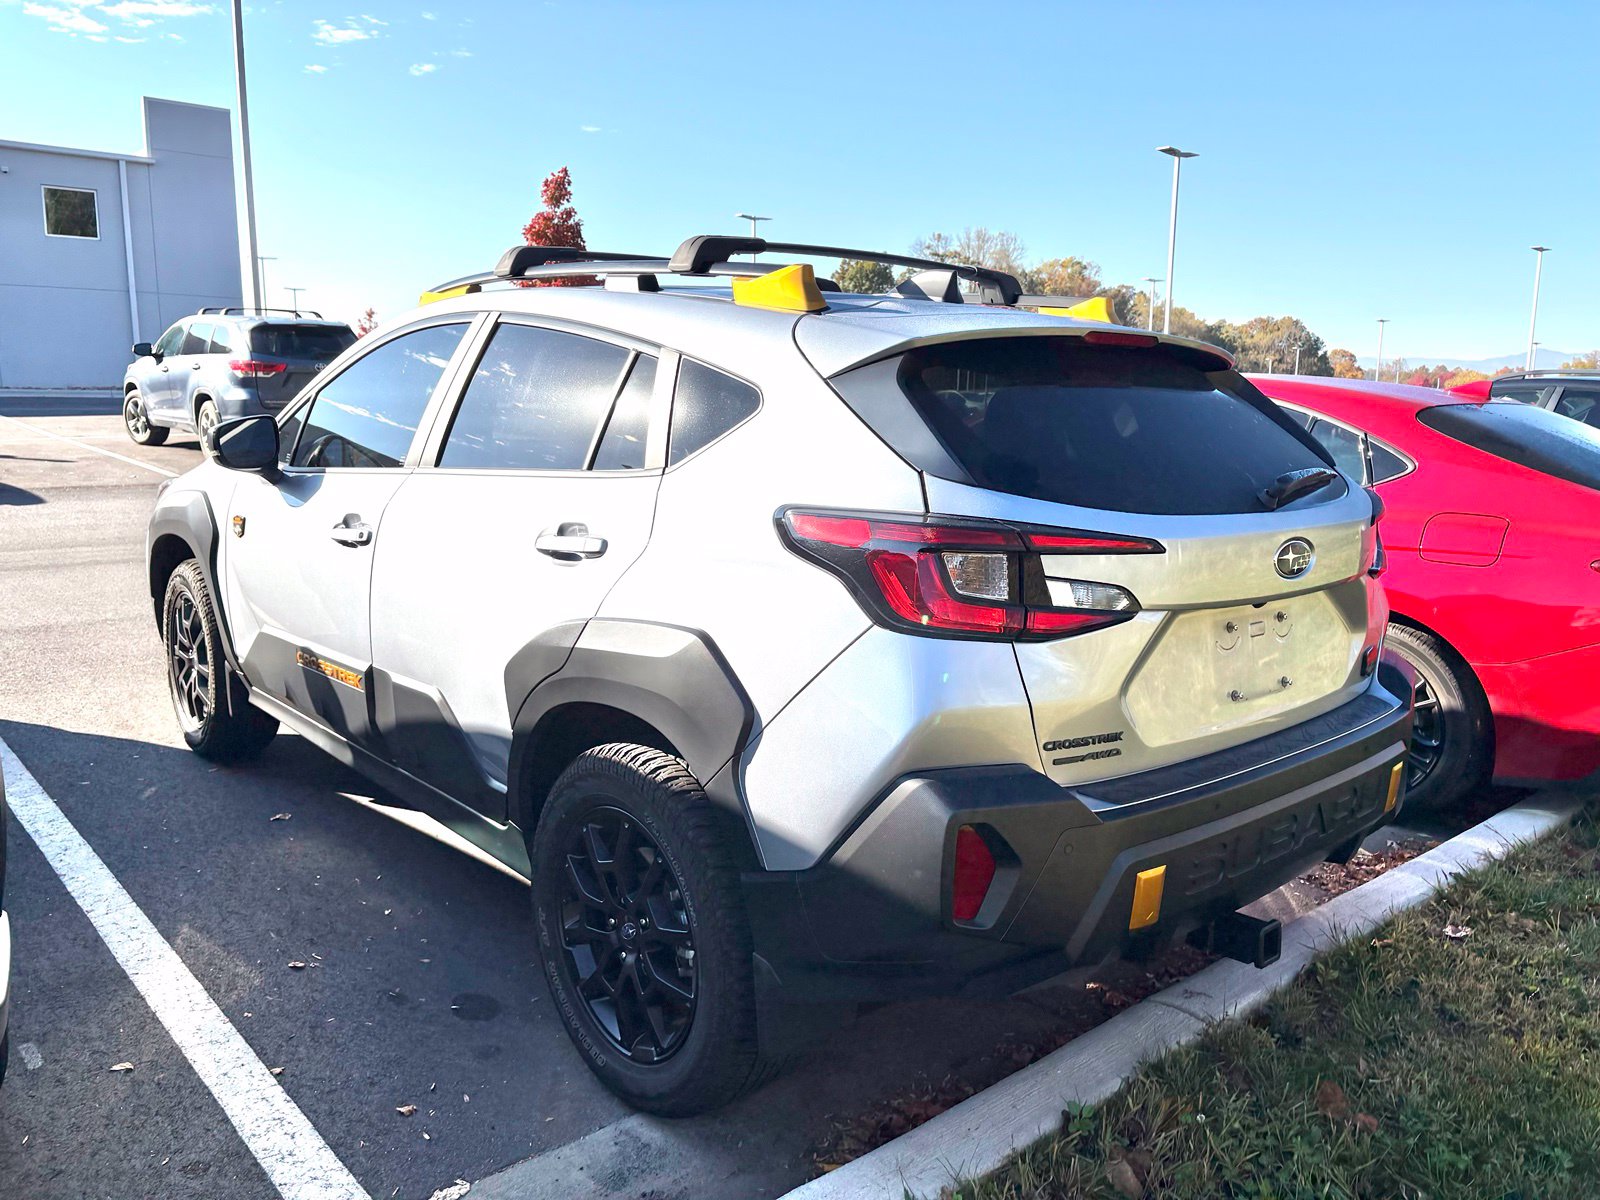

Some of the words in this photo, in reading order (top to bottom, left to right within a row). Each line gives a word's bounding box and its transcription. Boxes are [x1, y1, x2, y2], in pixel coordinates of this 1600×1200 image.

[296, 650, 363, 689] CROSSTREK
[1042, 731, 1124, 752] CROSSTREK
[1184, 777, 1382, 896] SUBARU
